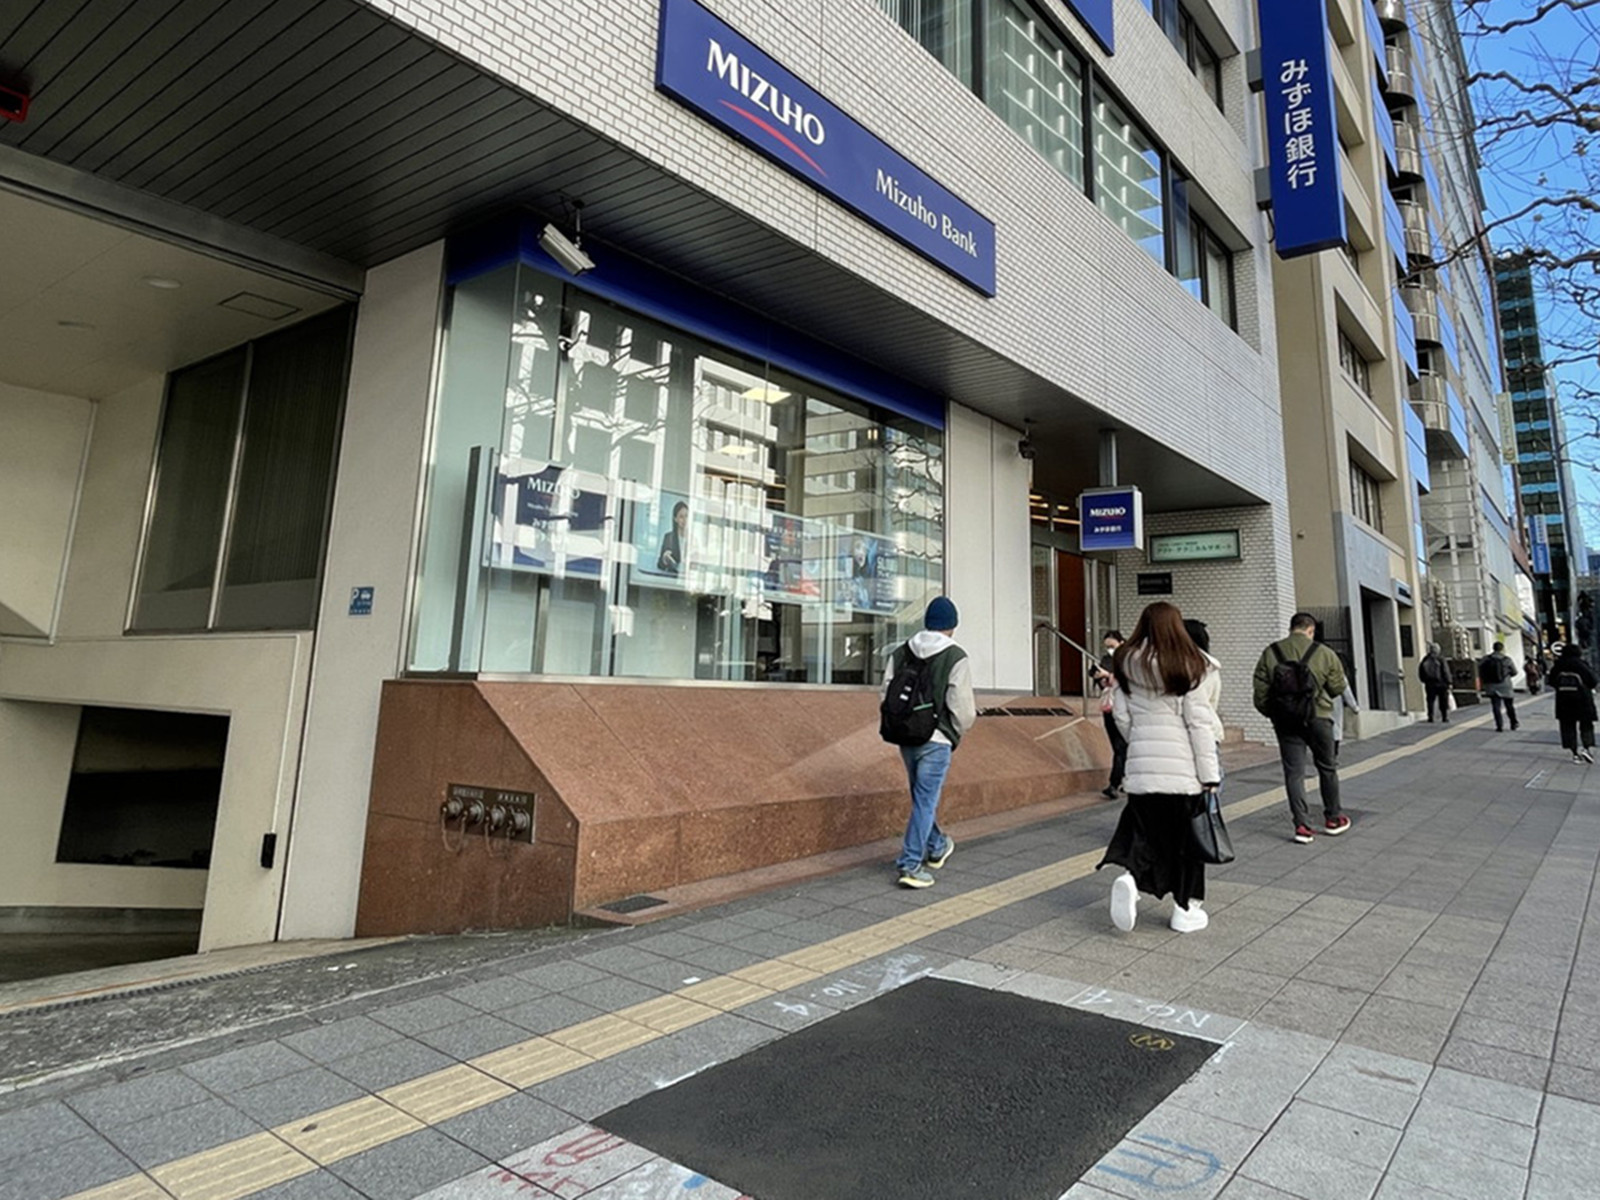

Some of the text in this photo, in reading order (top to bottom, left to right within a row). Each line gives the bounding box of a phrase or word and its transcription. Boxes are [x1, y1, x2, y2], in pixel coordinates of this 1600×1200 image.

[707, 38, 826, 146] MIZUHO
[1280, 58, 1318, 189] みずほ銀行
[876, 168, 979, 258] Mizuho Bank
